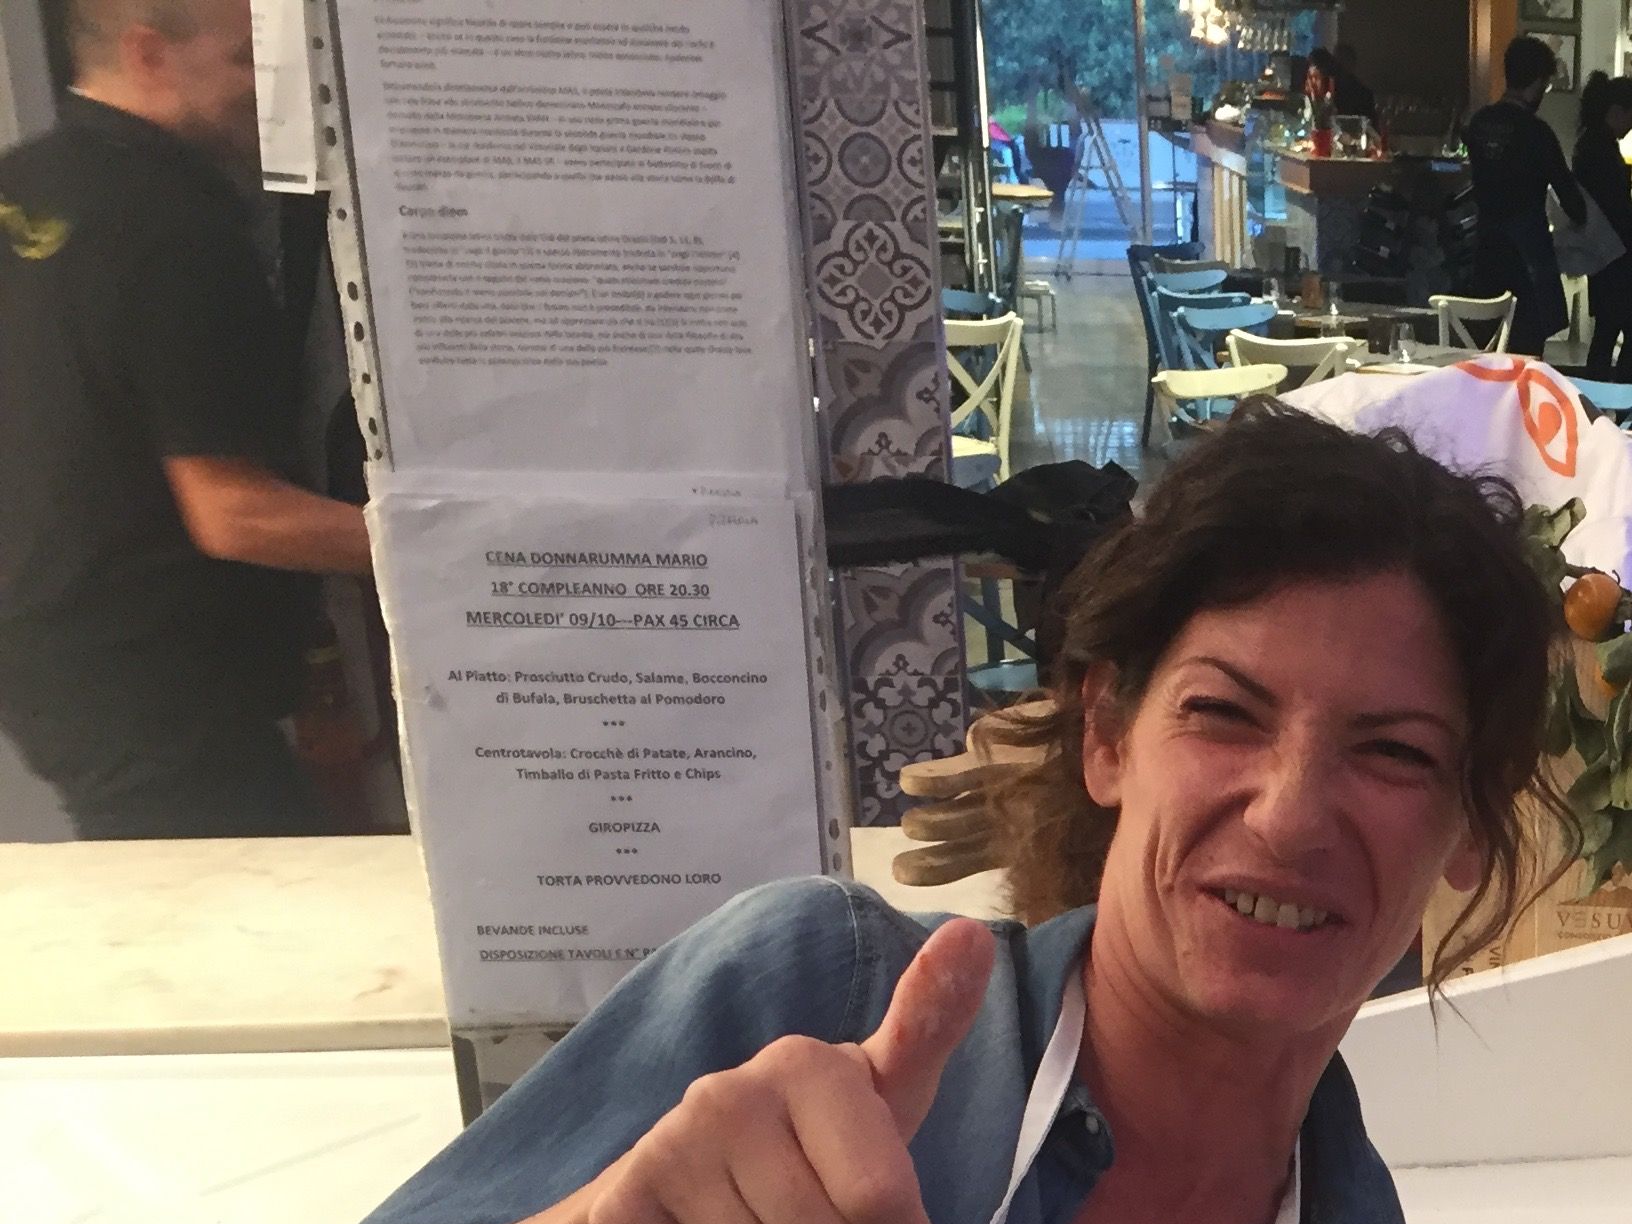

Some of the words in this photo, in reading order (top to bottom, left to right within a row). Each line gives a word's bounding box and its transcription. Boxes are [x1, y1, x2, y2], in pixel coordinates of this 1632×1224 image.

[485, 551, 527, 564] CENA
[530, 552, 652, 566] DONNARUMMA
[656, 554, 708, 567] MARIO
[518, 582, 627, 596] COMPLEANNO
[635, 584, 665, 597] ORE
[669, 584, 710, 597] 20.30
[669, 614, 689, 628] 45
[693, 614, 740, 628] CIRCA
[515, 671, 585, 684] Prosciutto
[588, 671, 633, 685] Crudo,
[636, 672, 689, 686] Salame,
[692, 672, 768, 685] Bocconcino
[496, 692, 509, 704] di
[513, 692, 560, 705] Bufala,
[563, 693, 637, 705] Bruschetta
[656, 694, 726, 705] Pomodoro
[627, 747, 639, 759] di
[643, 748, 690, 760] Patate,
[694, 747, 757, 760] Arancino,
[517, 768, 574, 780] Timballo
[578, 768, 590, 780] di
[594, 769, 631, 780] Pasta
[634, 768, 671, 780] Fritto
[674, 769, 682, 780] e
[685, 768, 721, 782] Chips
[588, 822, 661, 833] GIROPIZZA
[537, 875, 582, 887] TORTA
[586, 874, 682, 886] PROVVEDONO
[685, 873, 722, 885] LORO
[477, 925, 535, 936] BEVANDE
[538, 925, 590, 936] INCLUSE
